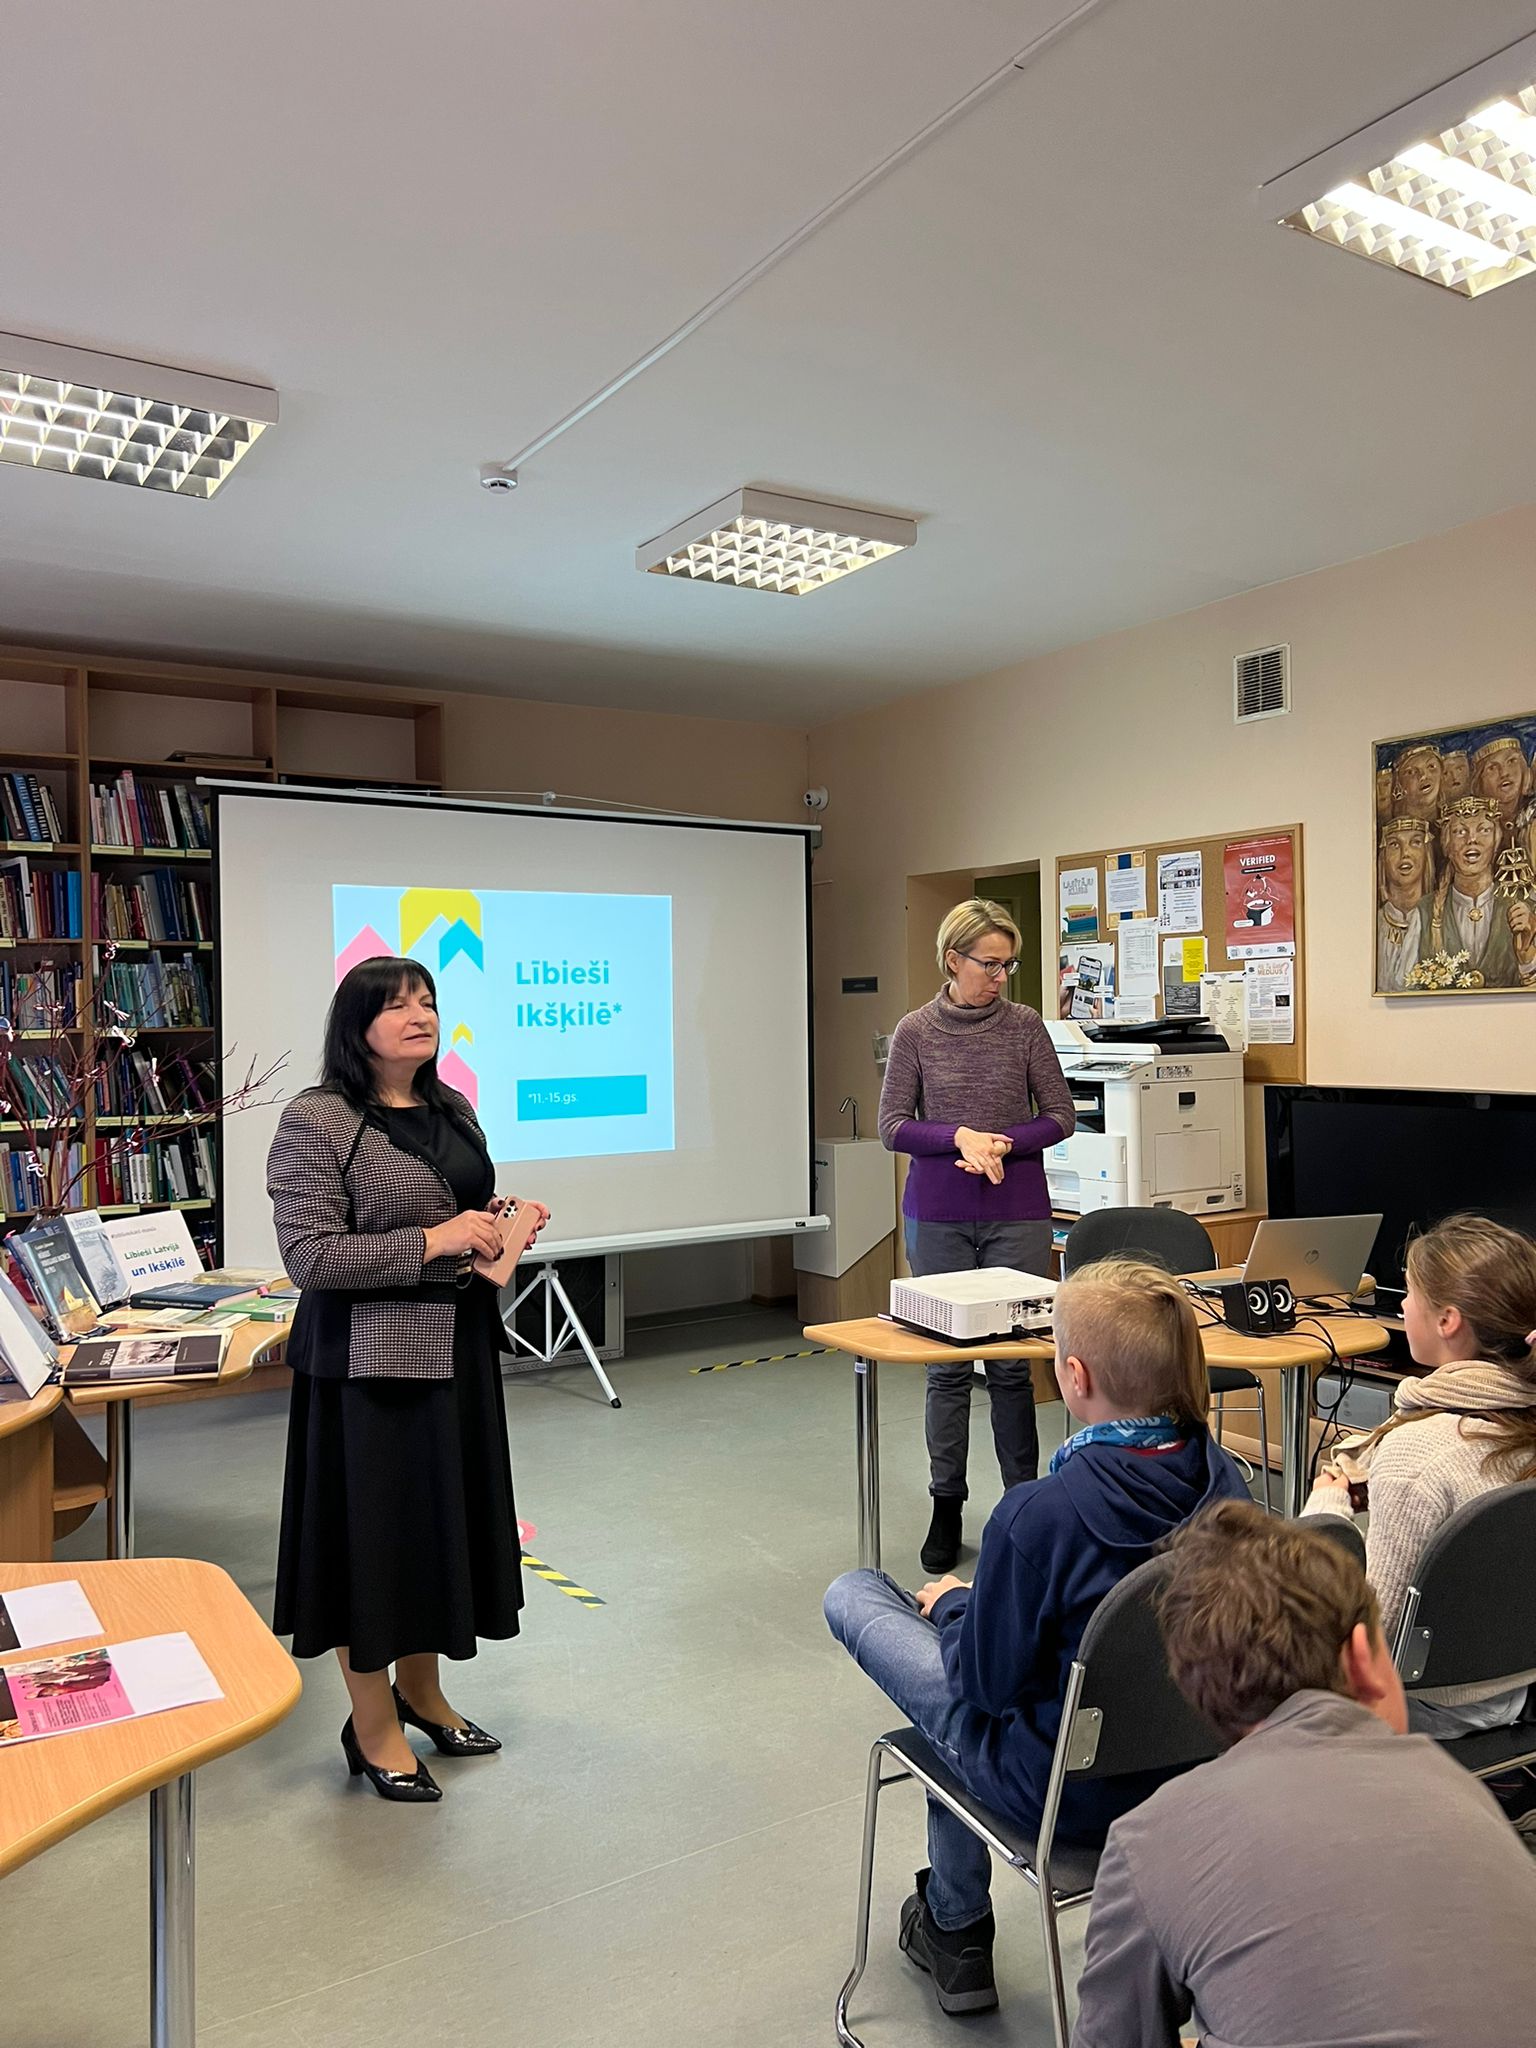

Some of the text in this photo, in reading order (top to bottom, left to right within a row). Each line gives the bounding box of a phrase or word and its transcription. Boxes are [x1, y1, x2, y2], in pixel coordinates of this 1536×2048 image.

[1239, 854, 1276, 866] VERIFIED
[516, 960, 609, 985] Lībieši
[131, 1266, 146, 1277] un
